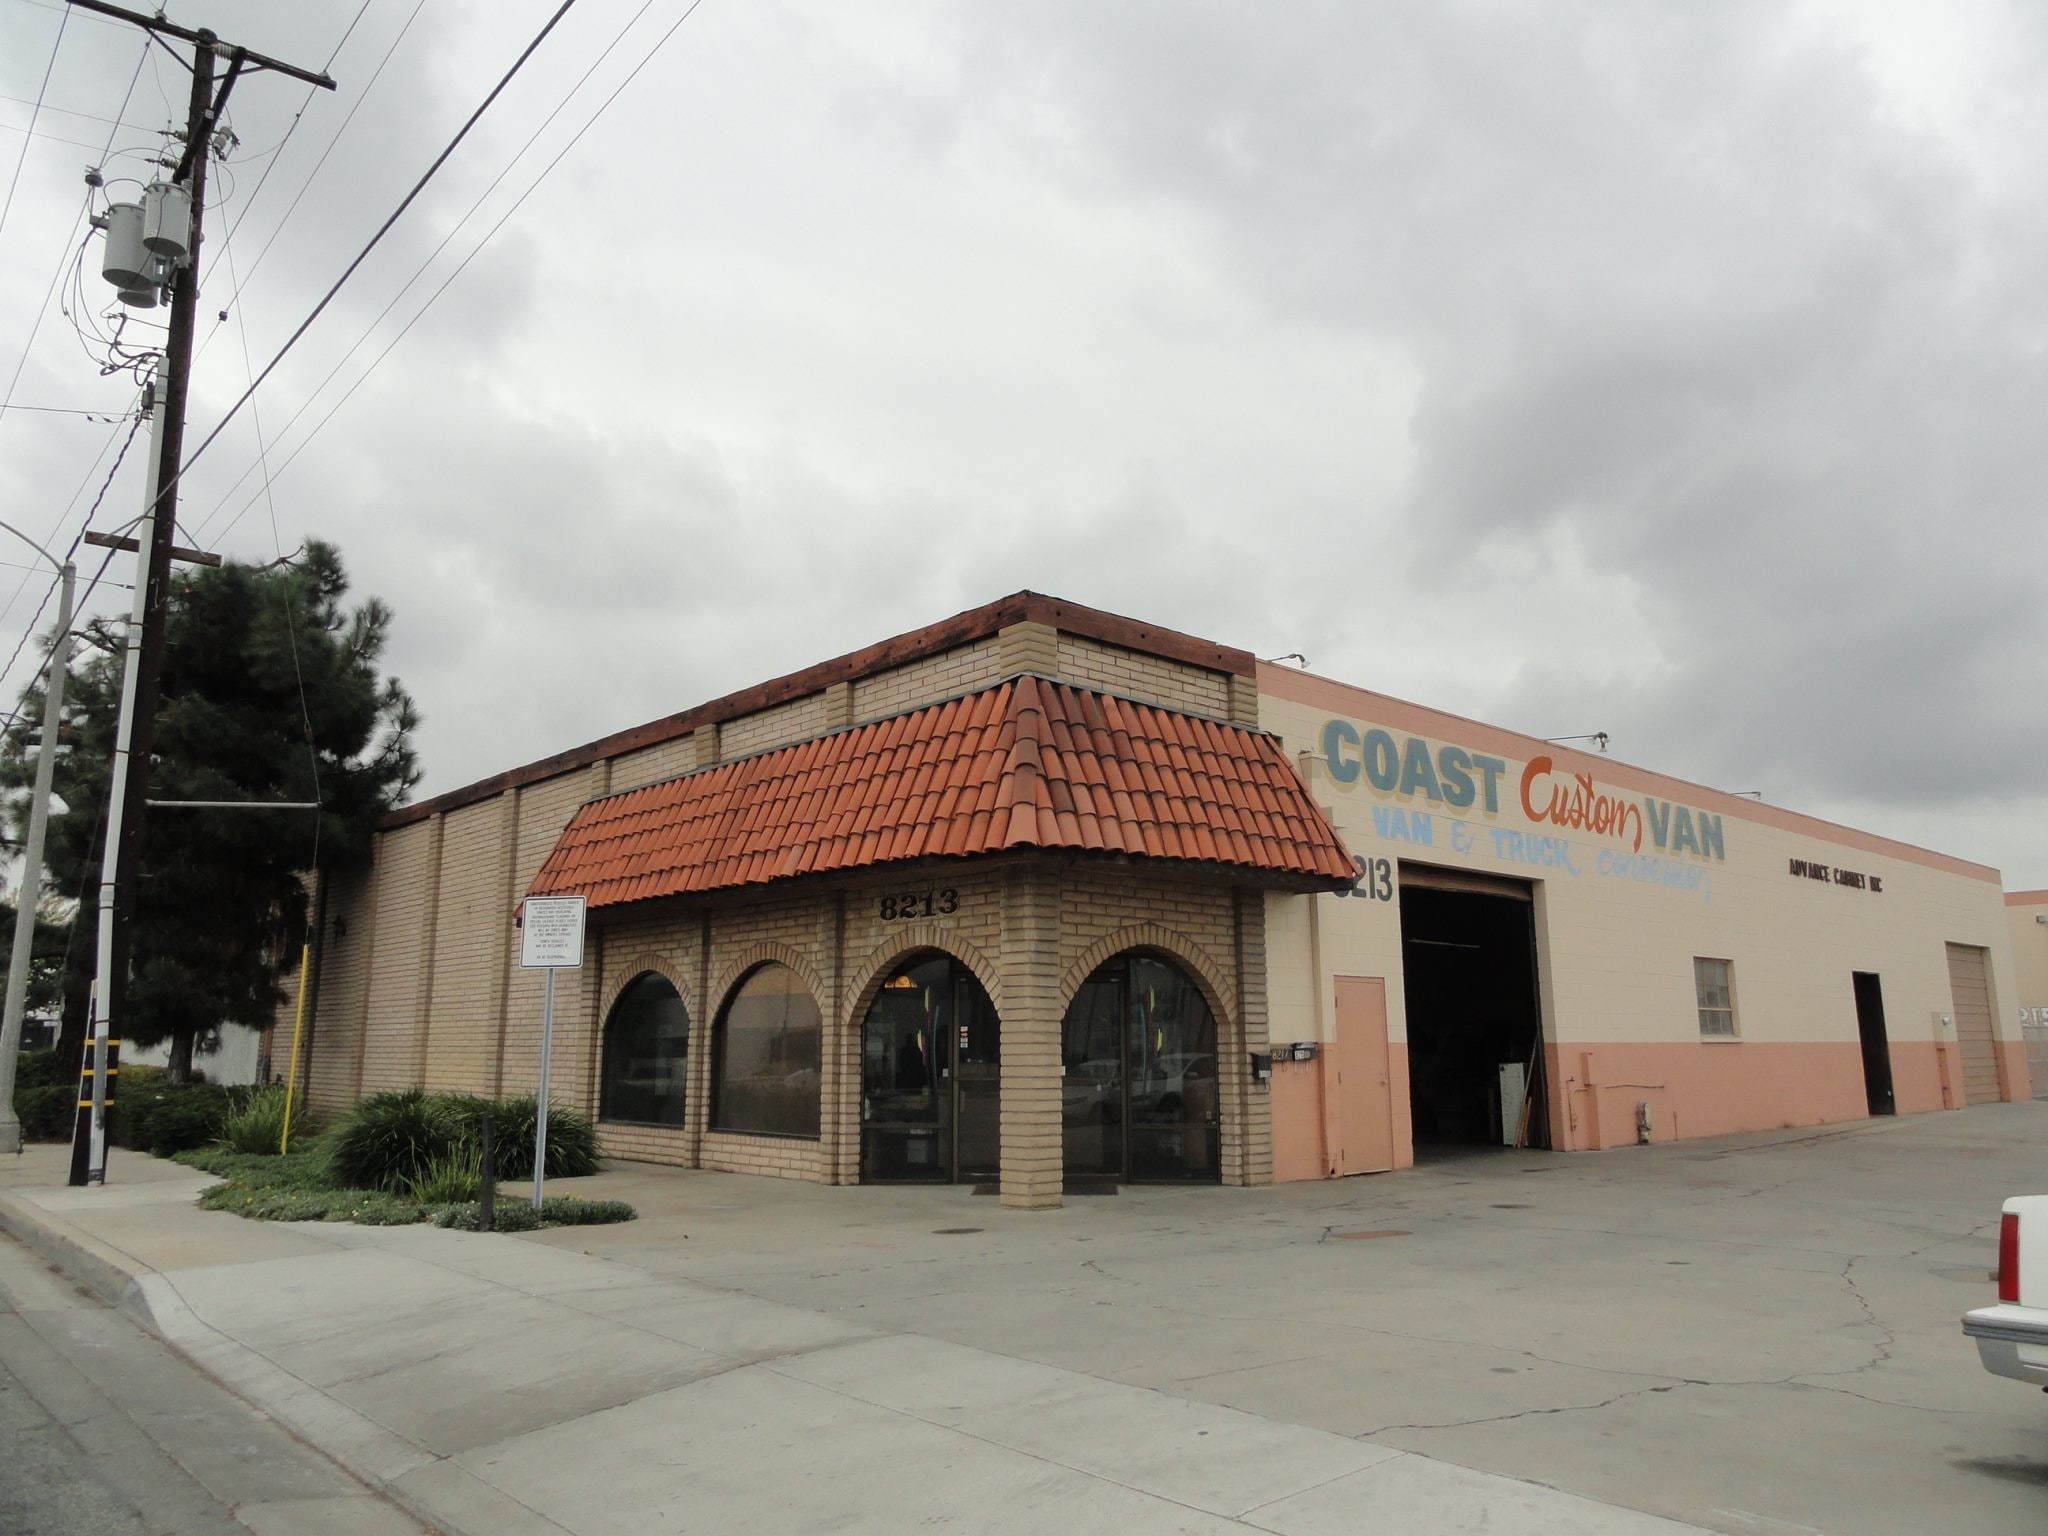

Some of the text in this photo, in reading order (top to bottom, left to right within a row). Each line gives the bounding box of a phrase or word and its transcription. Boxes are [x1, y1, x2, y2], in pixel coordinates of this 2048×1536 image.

[1320, 719, 1725, 863] COAST Custom VAN
[1372, 805, 1433, 846] VAN
[1452, 820, 1475, 857] &
[1488, 827, 1581, 877] TRUCK
[1333, 854, 1393, 902] 213
[1790, 858, 1830, 883] ADVANCE
[880, 888, 960, 920] 8213
